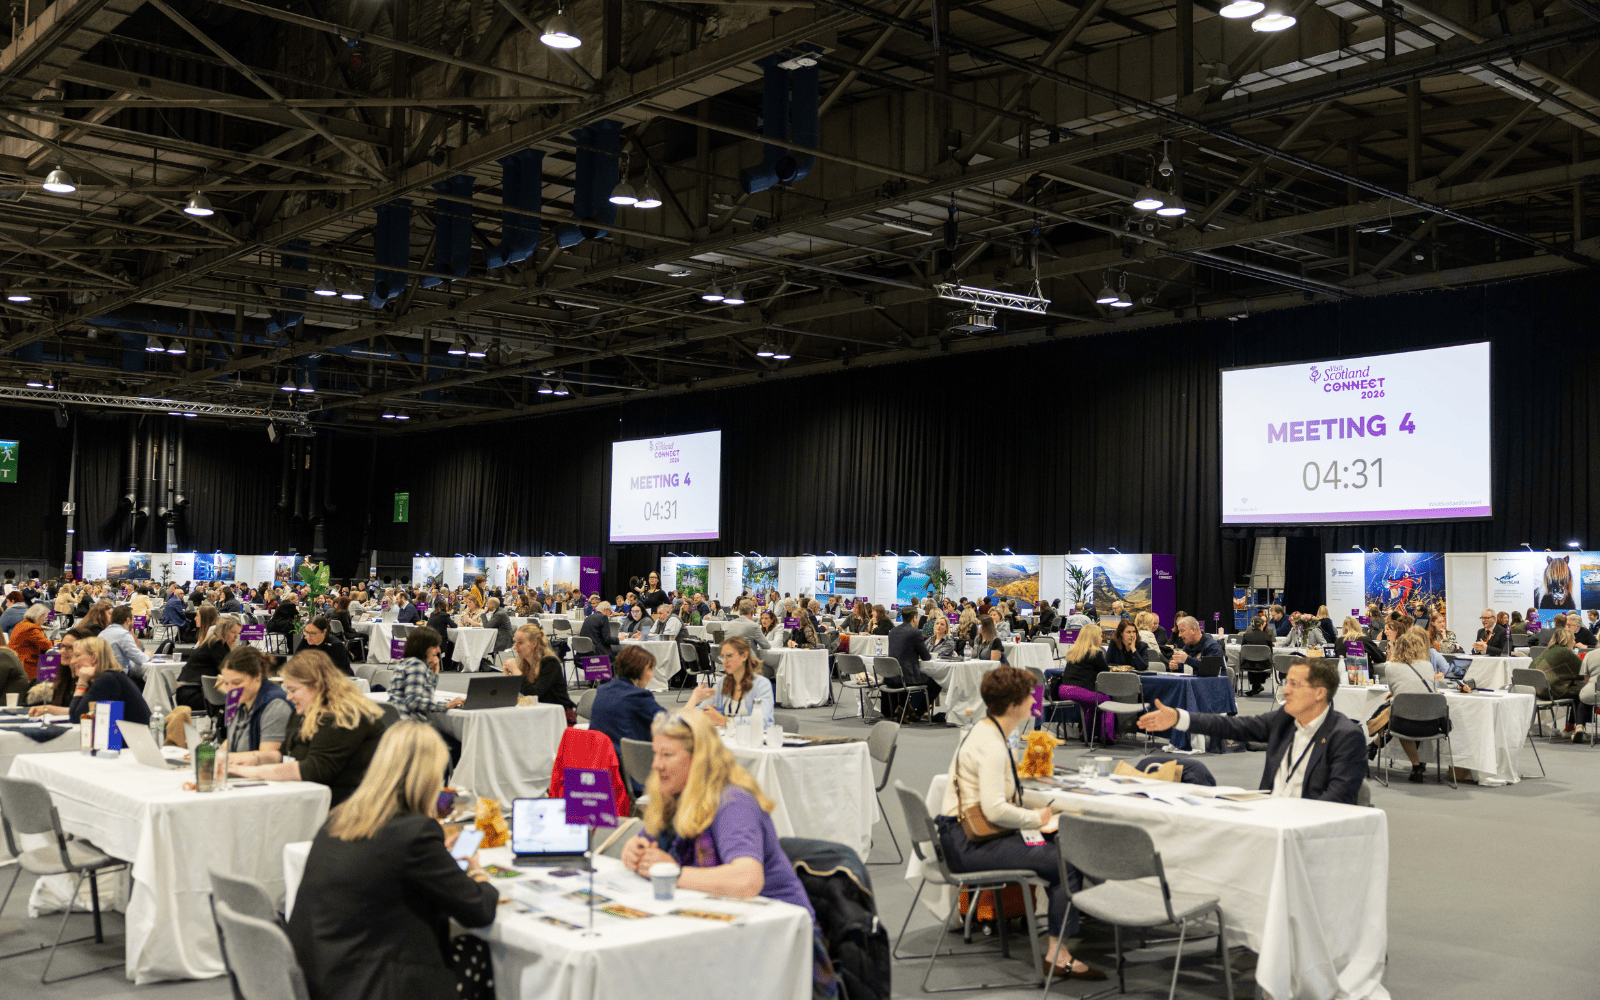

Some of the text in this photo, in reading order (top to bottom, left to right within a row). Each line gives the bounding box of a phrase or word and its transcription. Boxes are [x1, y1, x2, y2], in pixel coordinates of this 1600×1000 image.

[1324, 366, 1370, 381] Scotland
[1323, 378, 1385, 392] CONNECT
[1361, 390, 1385, 399] 2026
[1267, 412, 1416, 444] MEETING 4
[630, 472, 691, 490] MEETING 4
[1302, 457, 1384, 491] 04:31
[62, 502, 72, 514] 4
[644, 499, 678, 521] 04:31
